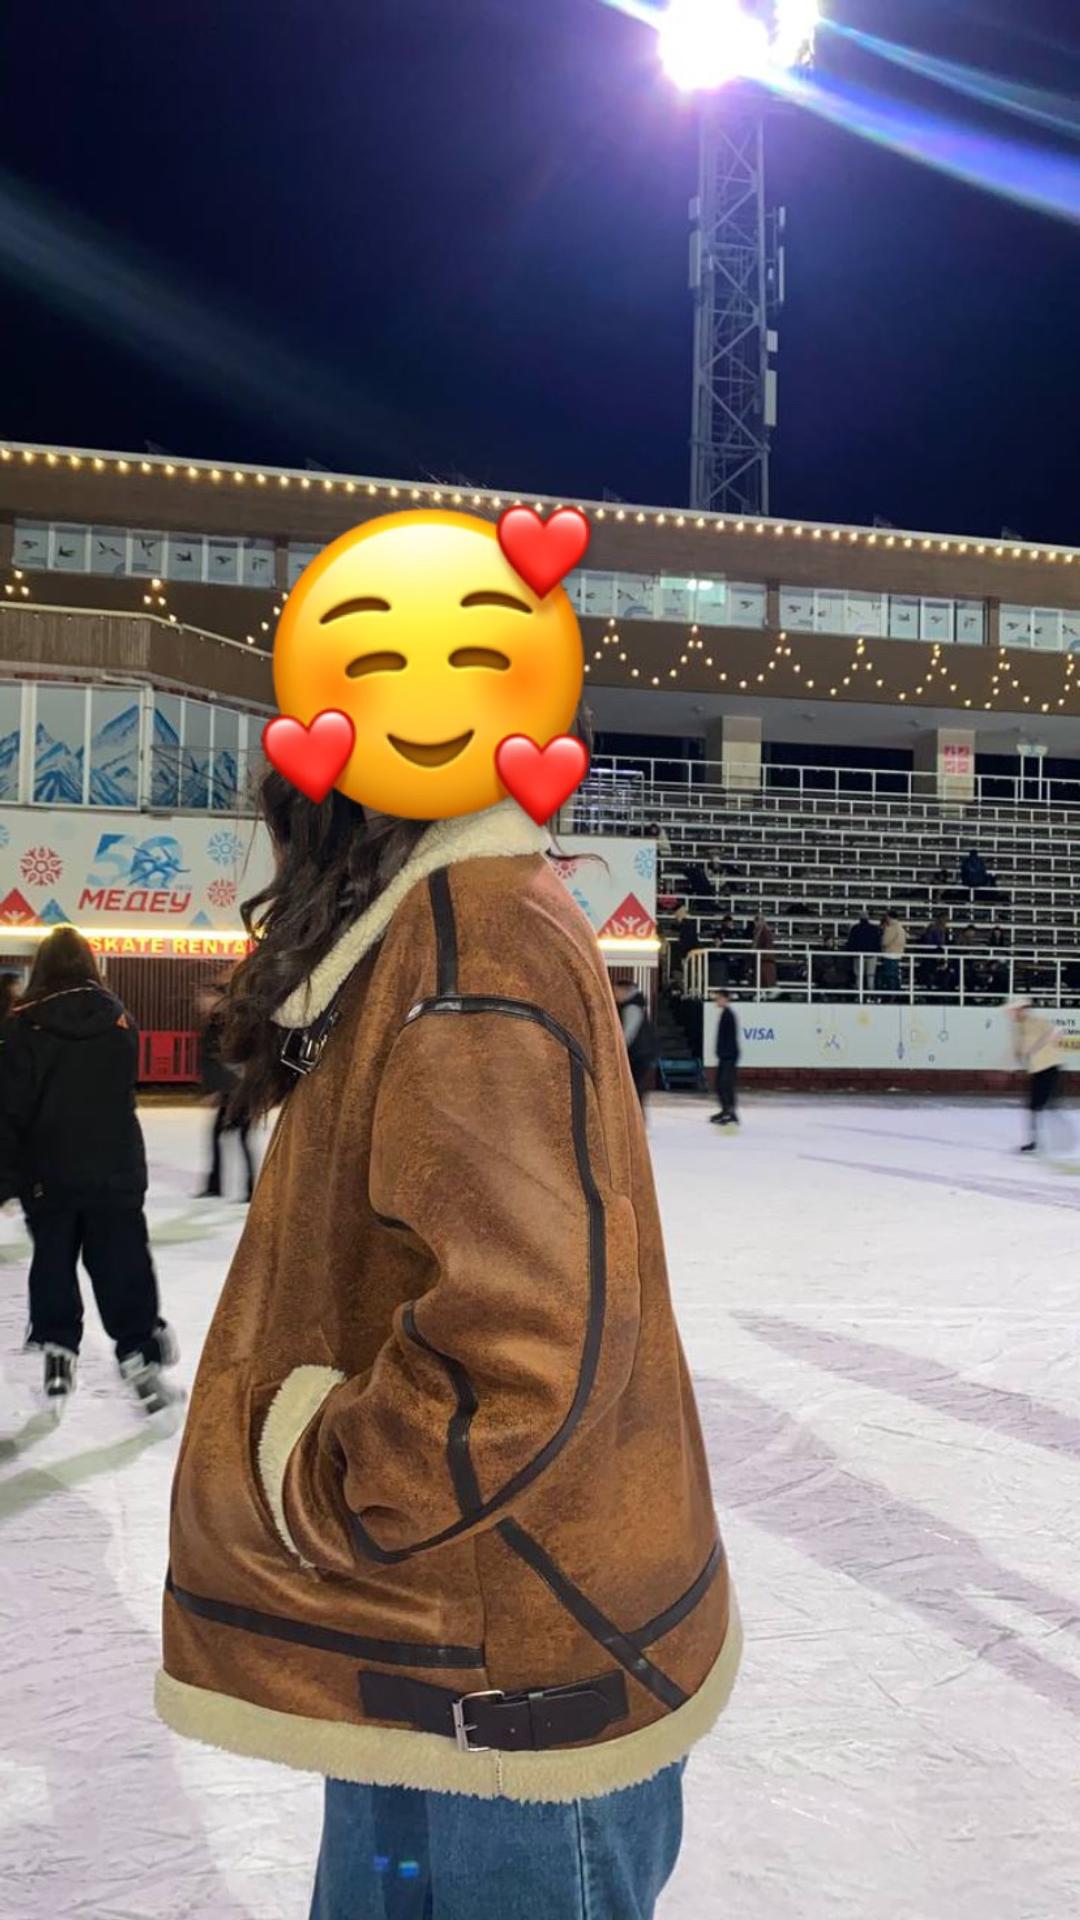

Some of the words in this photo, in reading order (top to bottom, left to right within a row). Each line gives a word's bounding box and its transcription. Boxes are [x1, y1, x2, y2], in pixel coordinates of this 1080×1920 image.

[78, 888, 191, 913] МЕДЕУ
[90, 937, 164, 953] SKATE
[172, 938, 254, 956] RENTA
[743, 1027, 775, 1040] VISA
